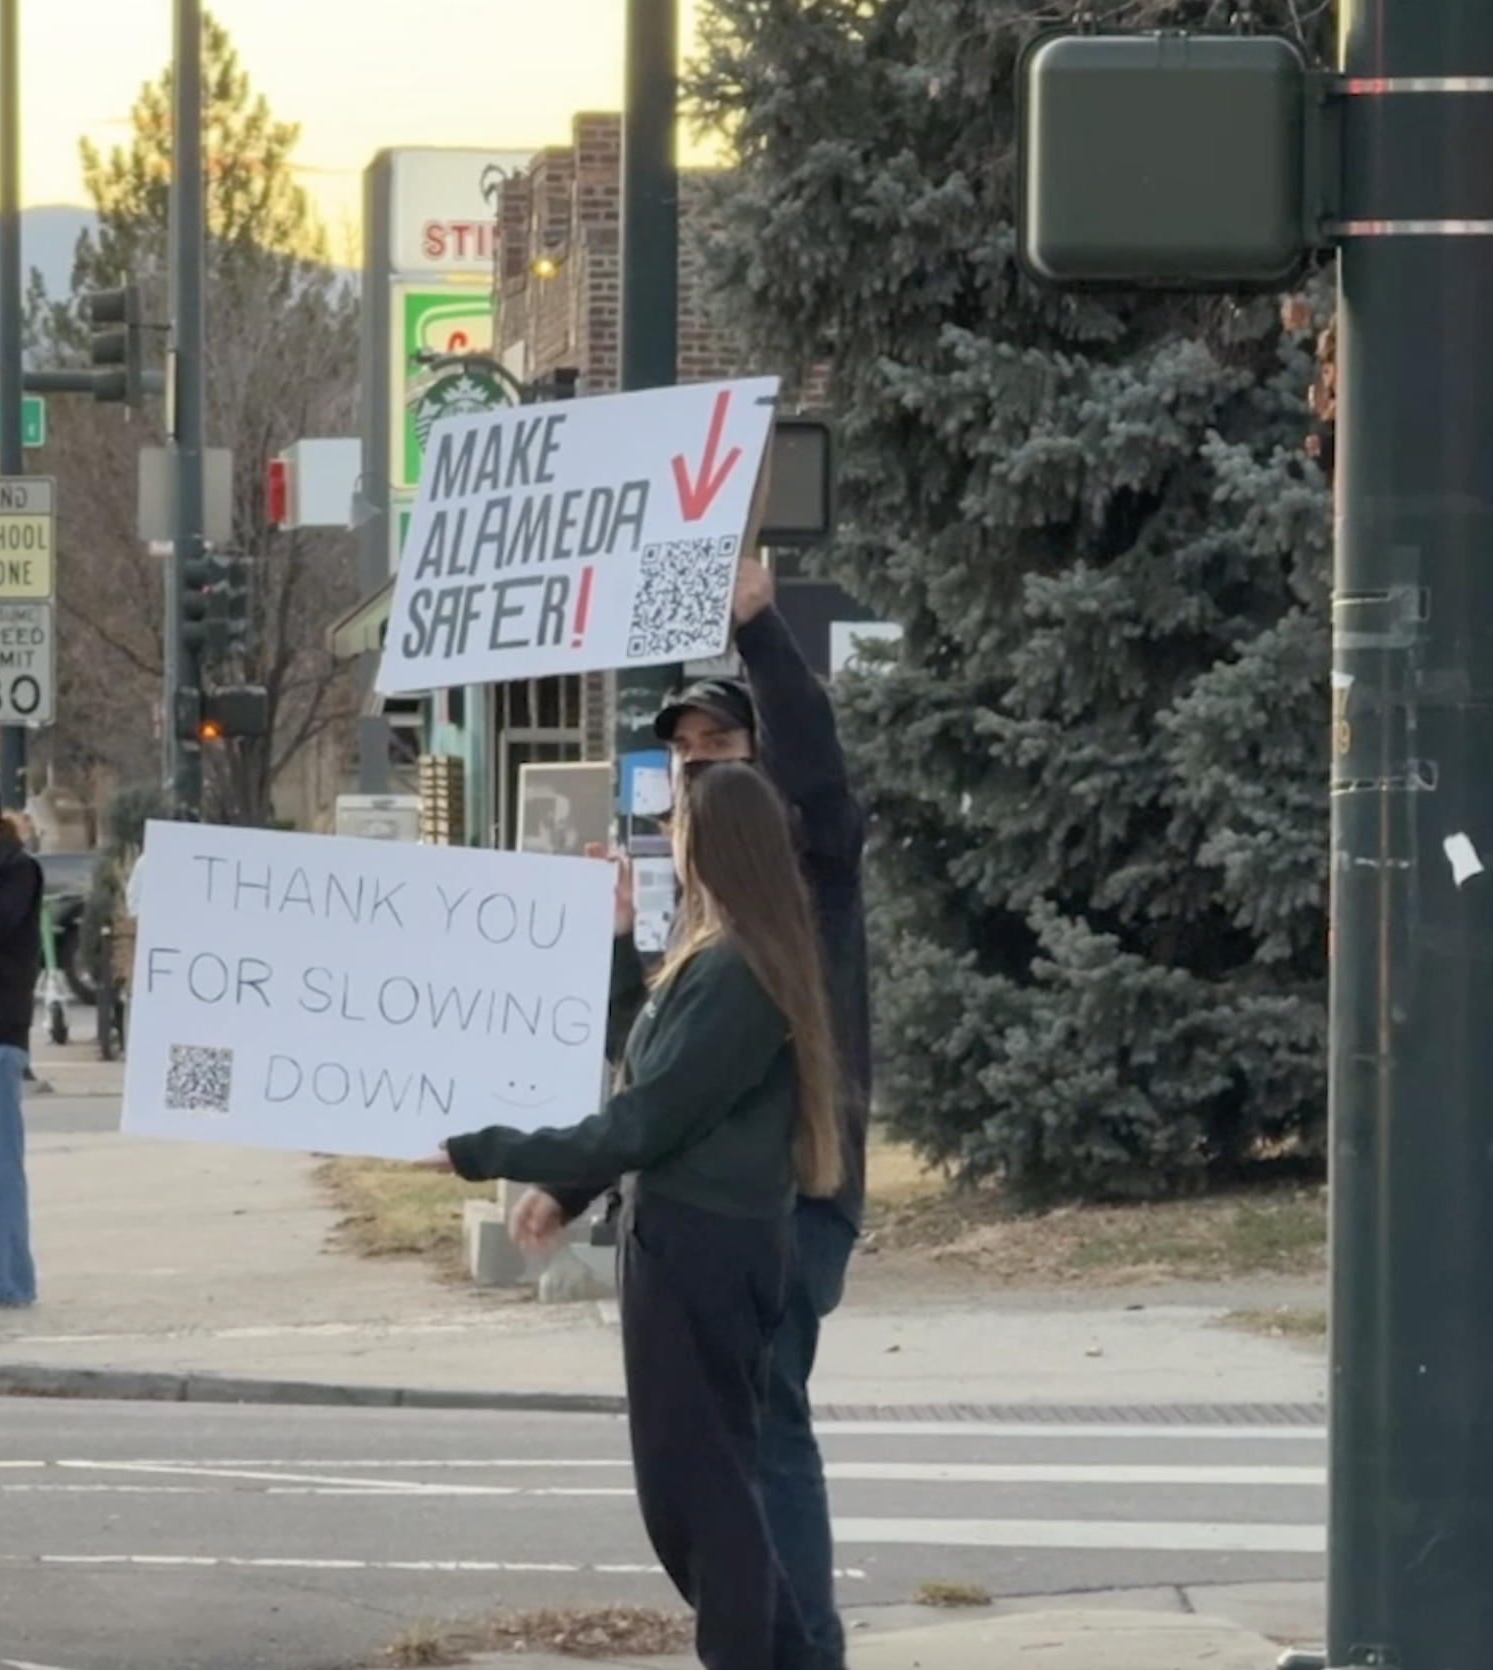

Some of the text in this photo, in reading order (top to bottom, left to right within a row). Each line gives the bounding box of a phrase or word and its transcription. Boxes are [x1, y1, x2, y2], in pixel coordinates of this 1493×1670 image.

[430, 413, 567, 502] MAKE
[414, 479, 650, 580] ALAMEDA
[402, 565, 594, 659] SAFER!
[192, 855, 407, 928] THANK
[437, 885, 567, 949] YOU
[147, 947, 593, 1046] FOR SLOWING
[264, 1054, 456, 1115] DOWN
